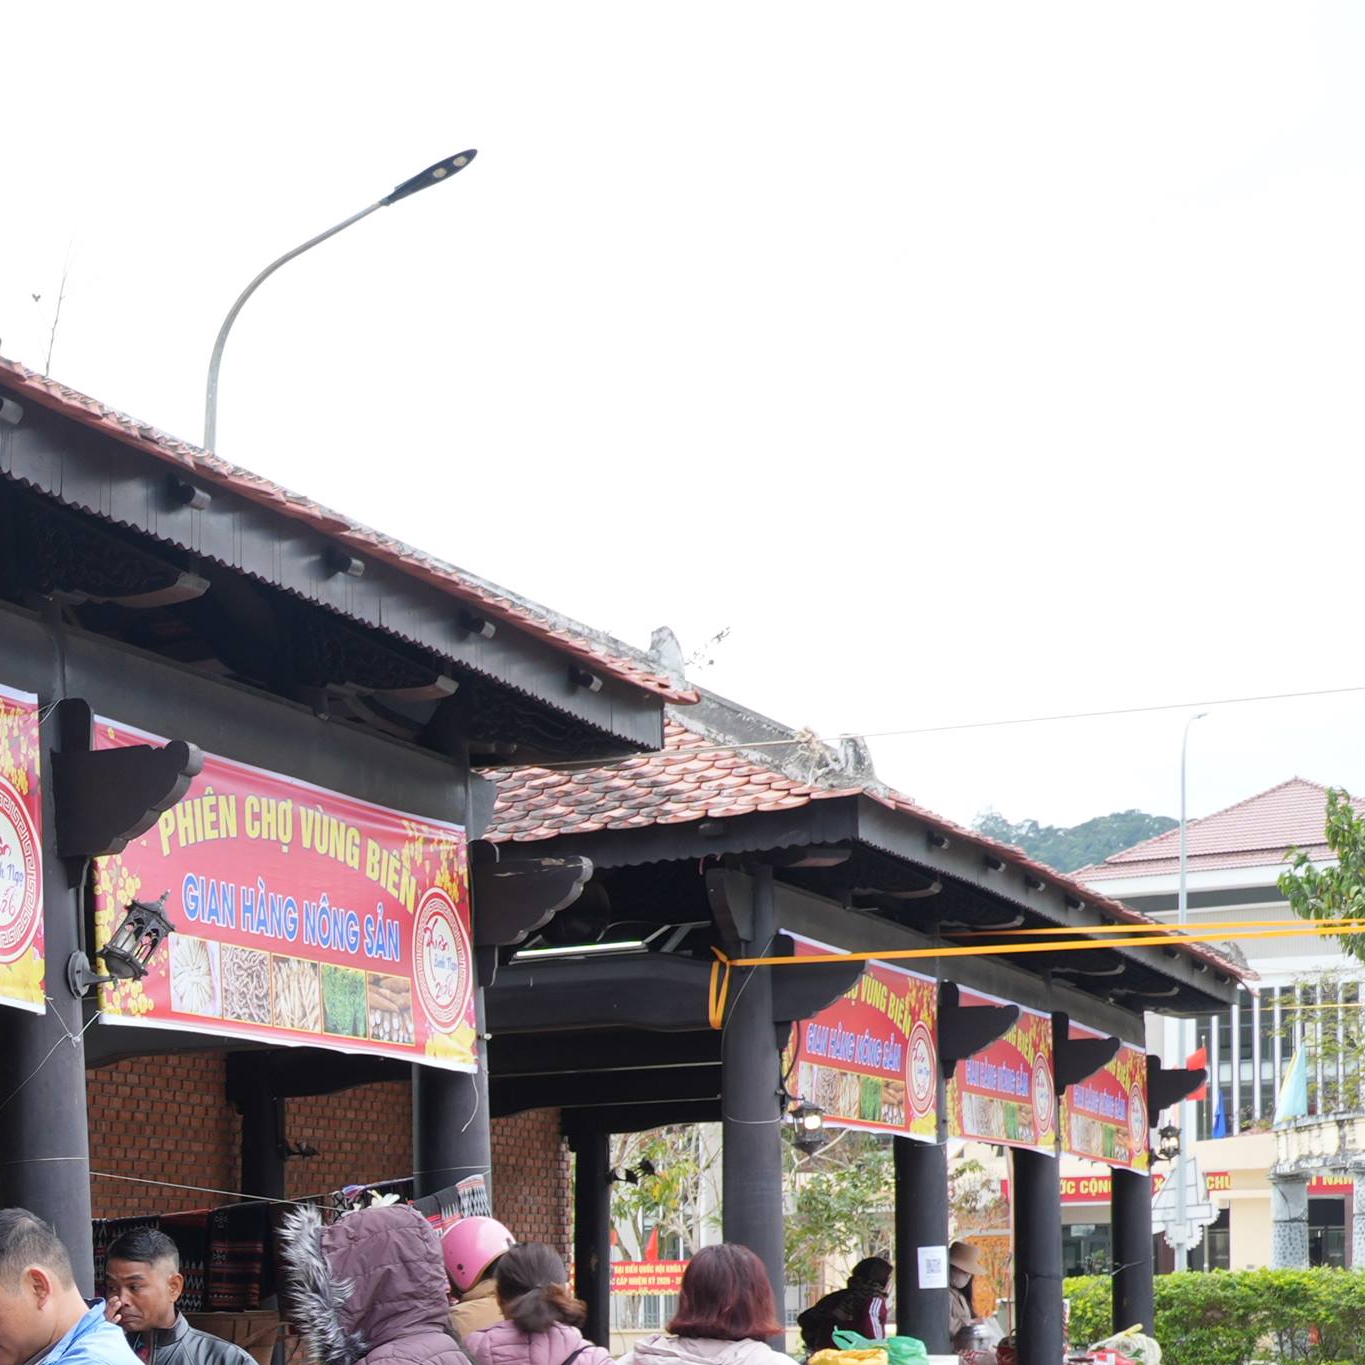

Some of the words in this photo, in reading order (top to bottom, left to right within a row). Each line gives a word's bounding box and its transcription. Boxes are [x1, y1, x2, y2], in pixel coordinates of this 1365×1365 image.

[158, 786, 237, 857] PHIÊN
[244, 795, 293, 853] CHỢ
[299, 804, 361, 870] VÙNG
[365, 837, 417, 915] BIÊN
[182, 872, 236, 929] GIAN
[240, 876, 299, 942] HÀNG
[303, 892, 360, 954] NÔNG
[364, 902, 400, 962] SẢN
[861, 971, 888, 1013] VÙNG
